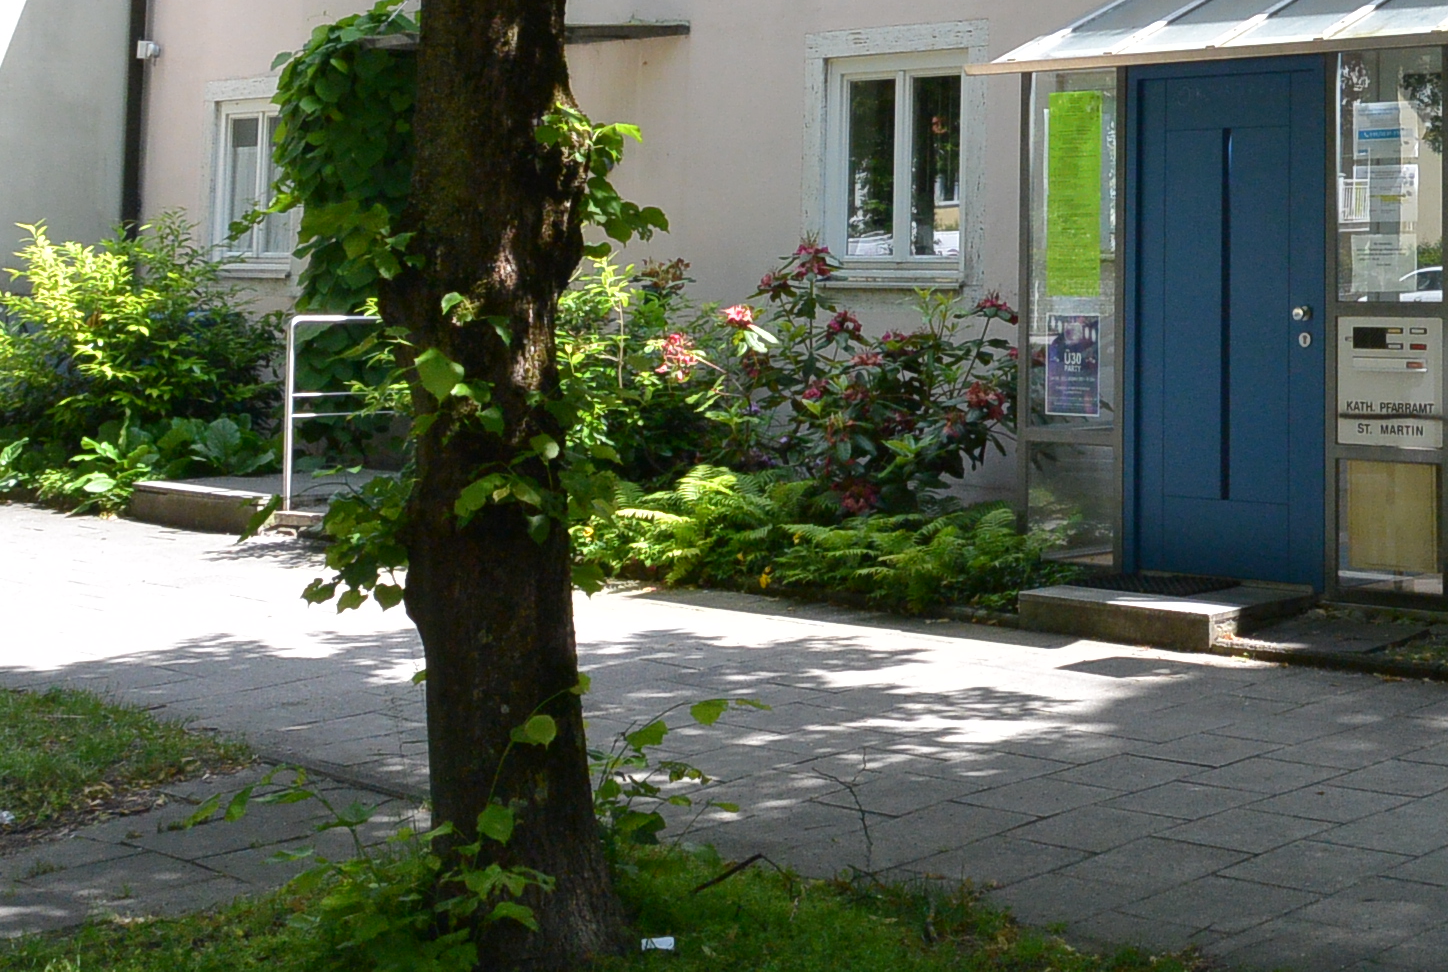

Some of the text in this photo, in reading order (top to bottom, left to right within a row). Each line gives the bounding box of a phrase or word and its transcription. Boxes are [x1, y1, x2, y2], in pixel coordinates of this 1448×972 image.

[1063, 349, 1082, 365] Ü30
[1063, 365, 1082, 373] PARTY
[1346, 400, 1435, 414] KATH. PFARRAMT
[1357, 422, 1424, 436] ST. MARTIN
